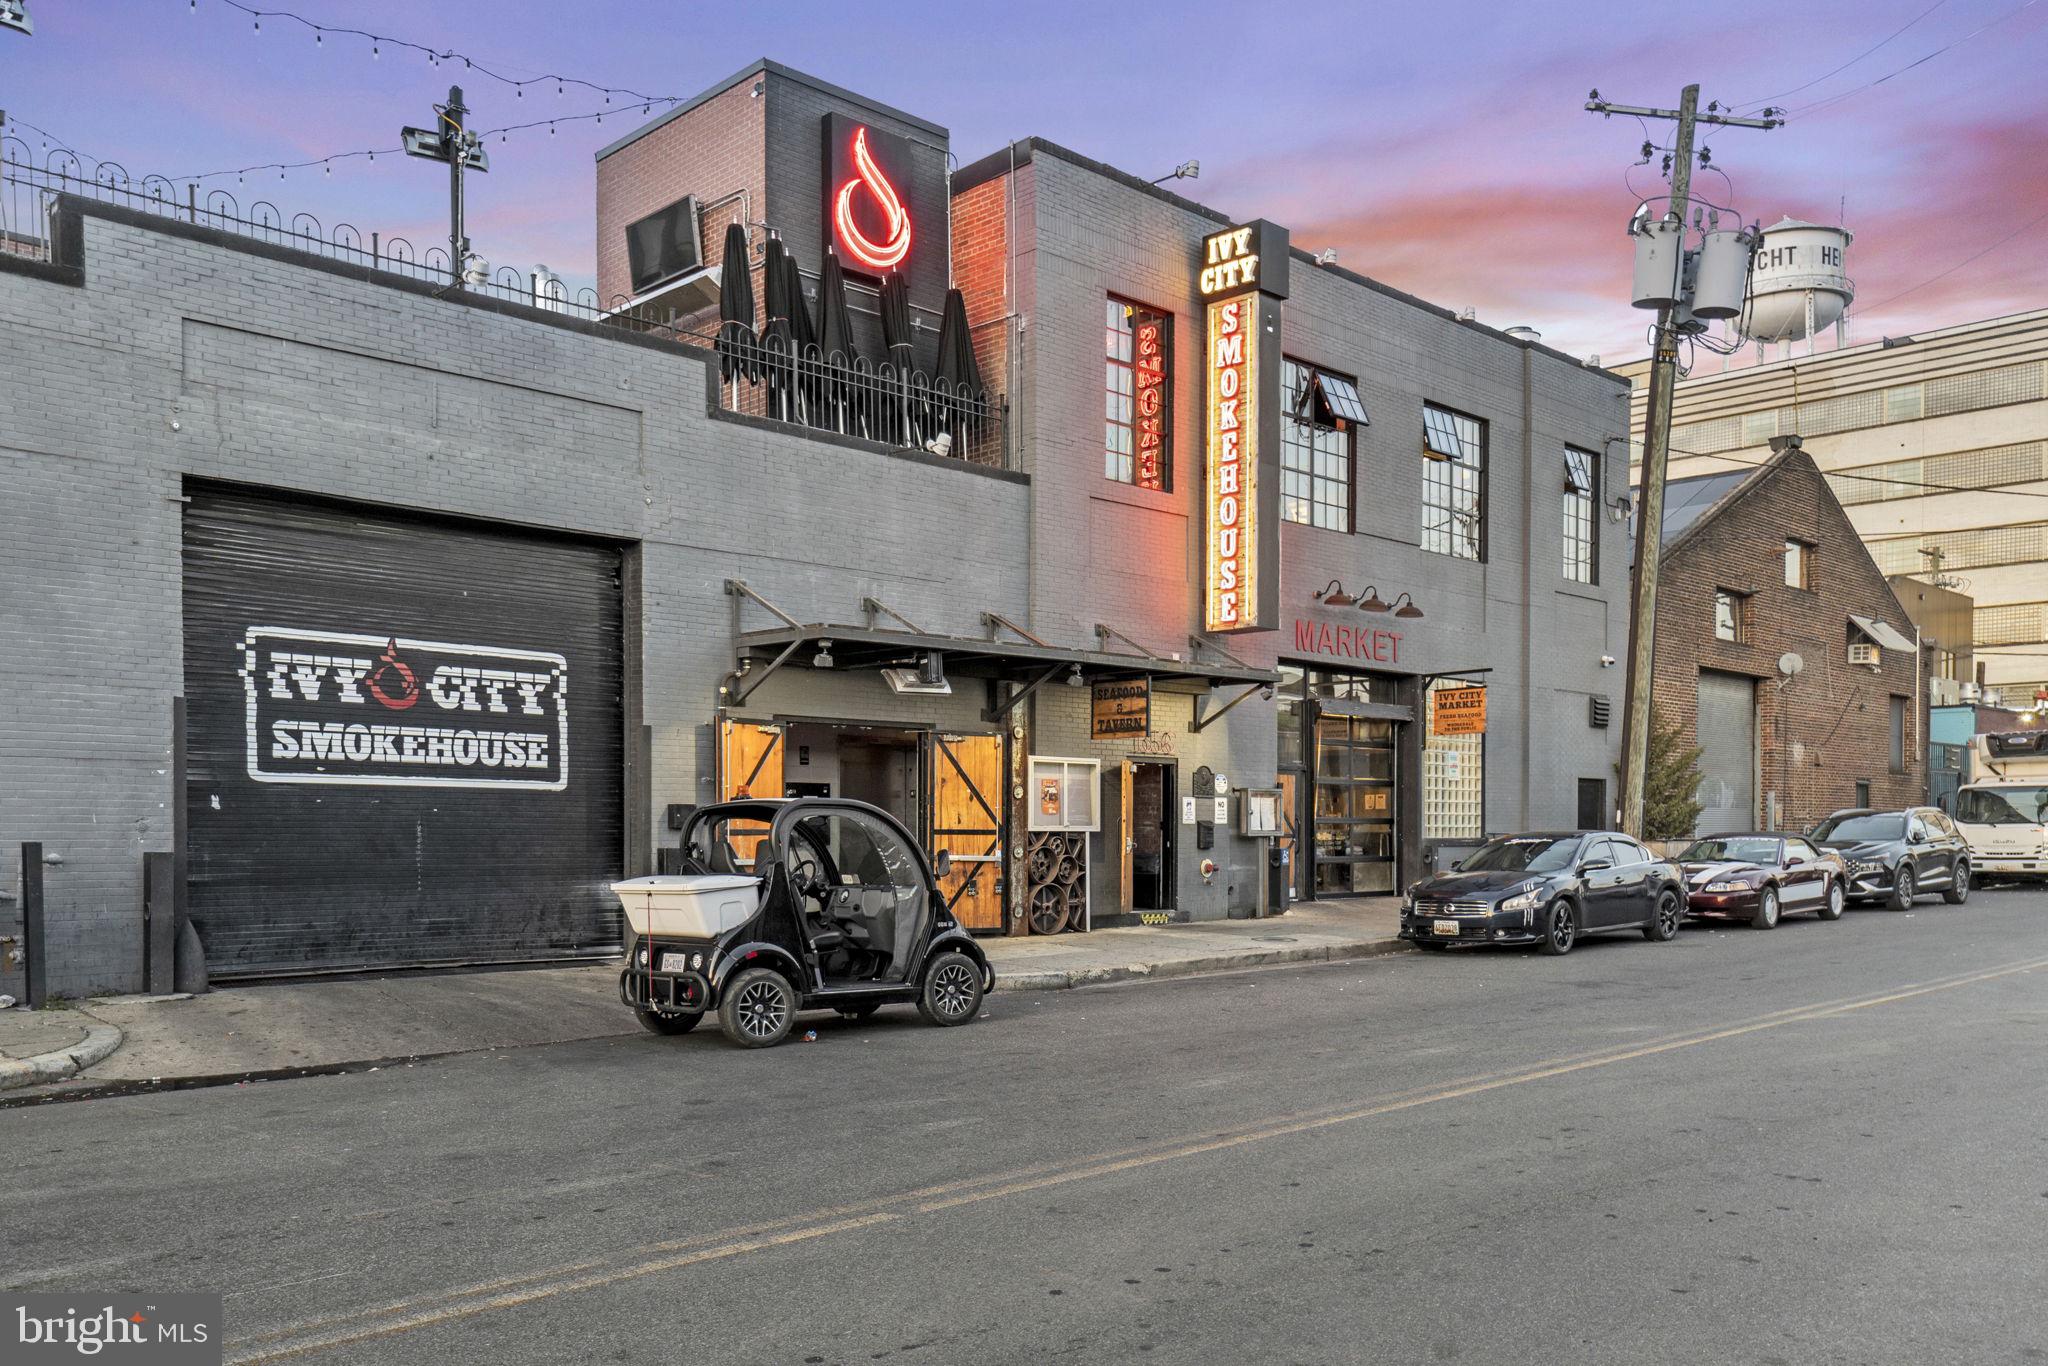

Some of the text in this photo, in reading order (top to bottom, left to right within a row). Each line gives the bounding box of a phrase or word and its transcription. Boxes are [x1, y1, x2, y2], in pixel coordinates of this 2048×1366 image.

[1208, 227, 1252, 264] IVY
[1753, 245, 1797, 271] CHT
[1201, 255, 1258, 294] CITY
[1216, 302, 1244, 622] SMOKEHOUSE
[1295, 619, 1404, 663] MARKET
[267, 652, 551, 715] IVY CITY
[1097, 686, 1144, 700] SEAFOOD
[1439, 690, 1482, 701] IVY CITY
[1438, 700, 1482, 710] MARKET
[271, 719, 549, 768] SMOKEHOUSE
[1097, 717, 1143, 733] TAVERN
